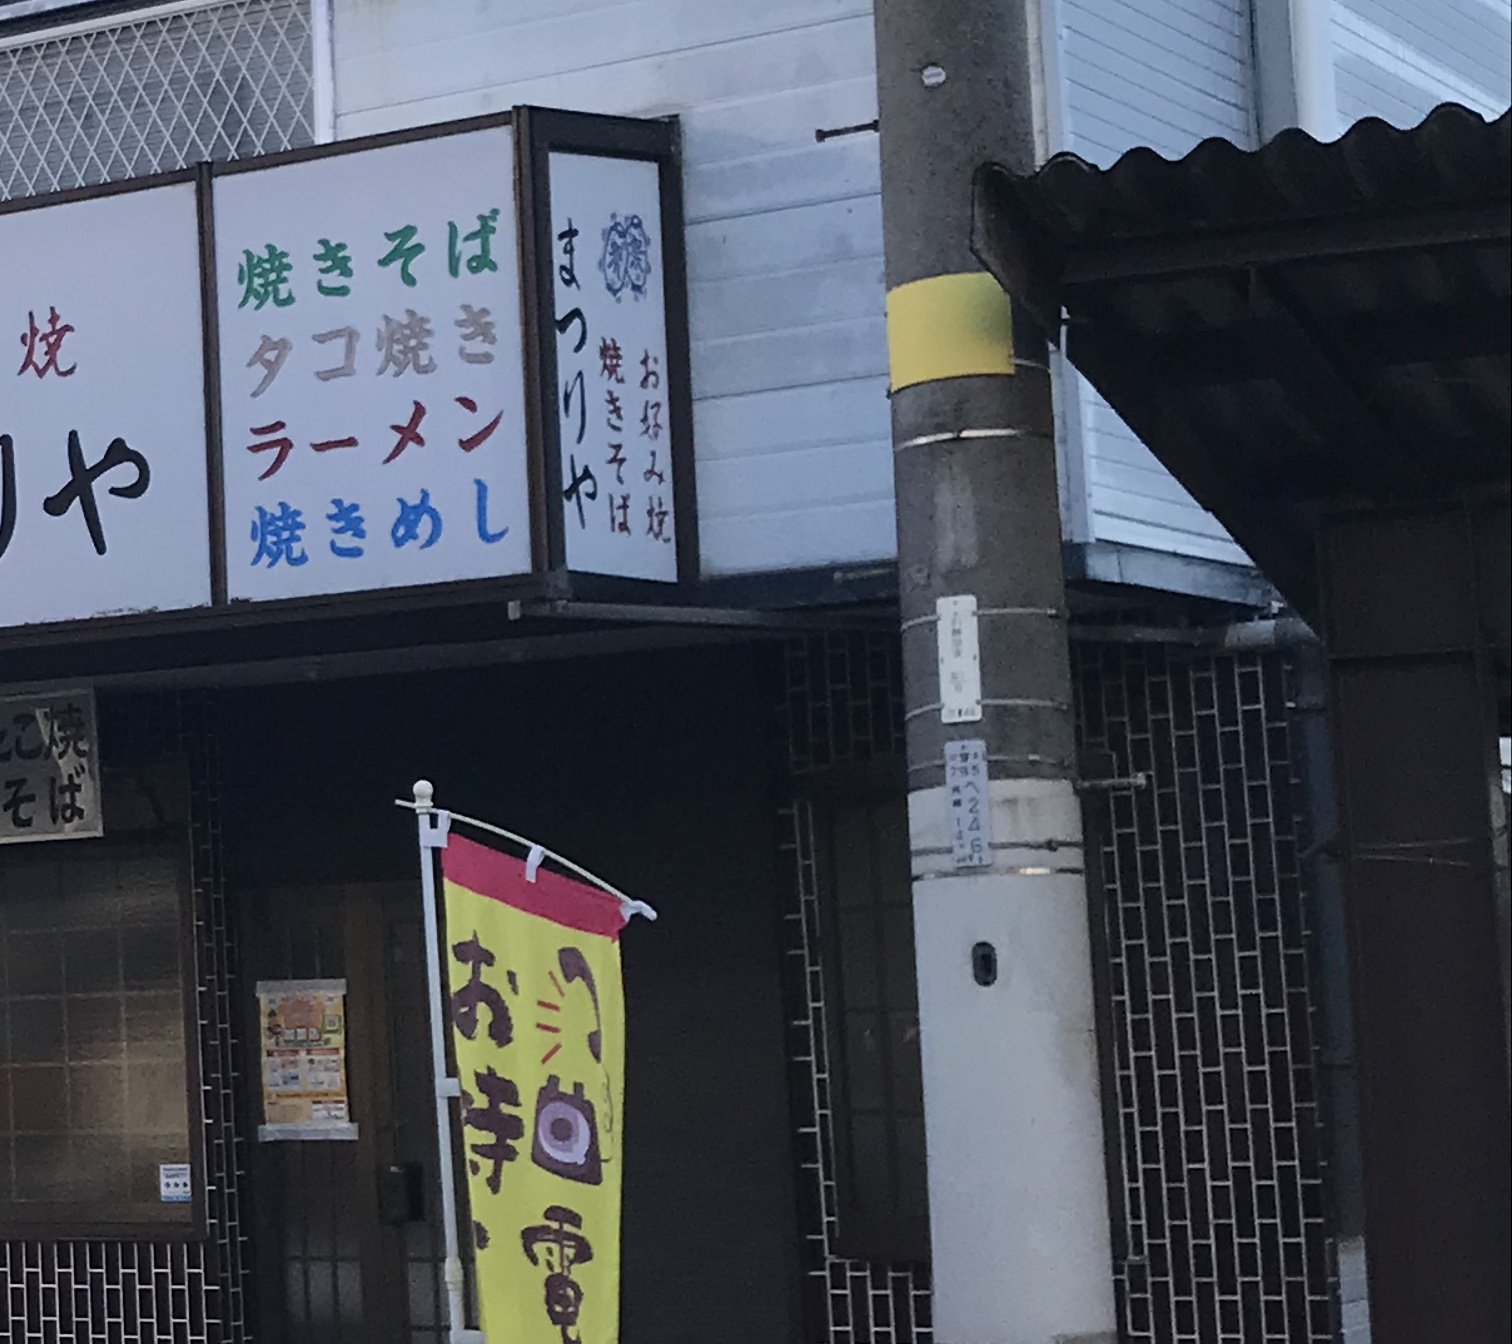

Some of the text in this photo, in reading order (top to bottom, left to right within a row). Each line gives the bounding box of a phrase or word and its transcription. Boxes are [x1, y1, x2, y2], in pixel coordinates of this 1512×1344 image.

[236, 205, 502, 312] 焼きそば
[243, 302, 501, 397] タコ焼き
[553, 216, 598, 530] まつりや
[244, 390, 506, 481] ラーメン
[599, 335, 633, 539] 焼きそば
[639, 348, 672, 544] お好み焼
[248, 475, 511, 569] 焼きめし
